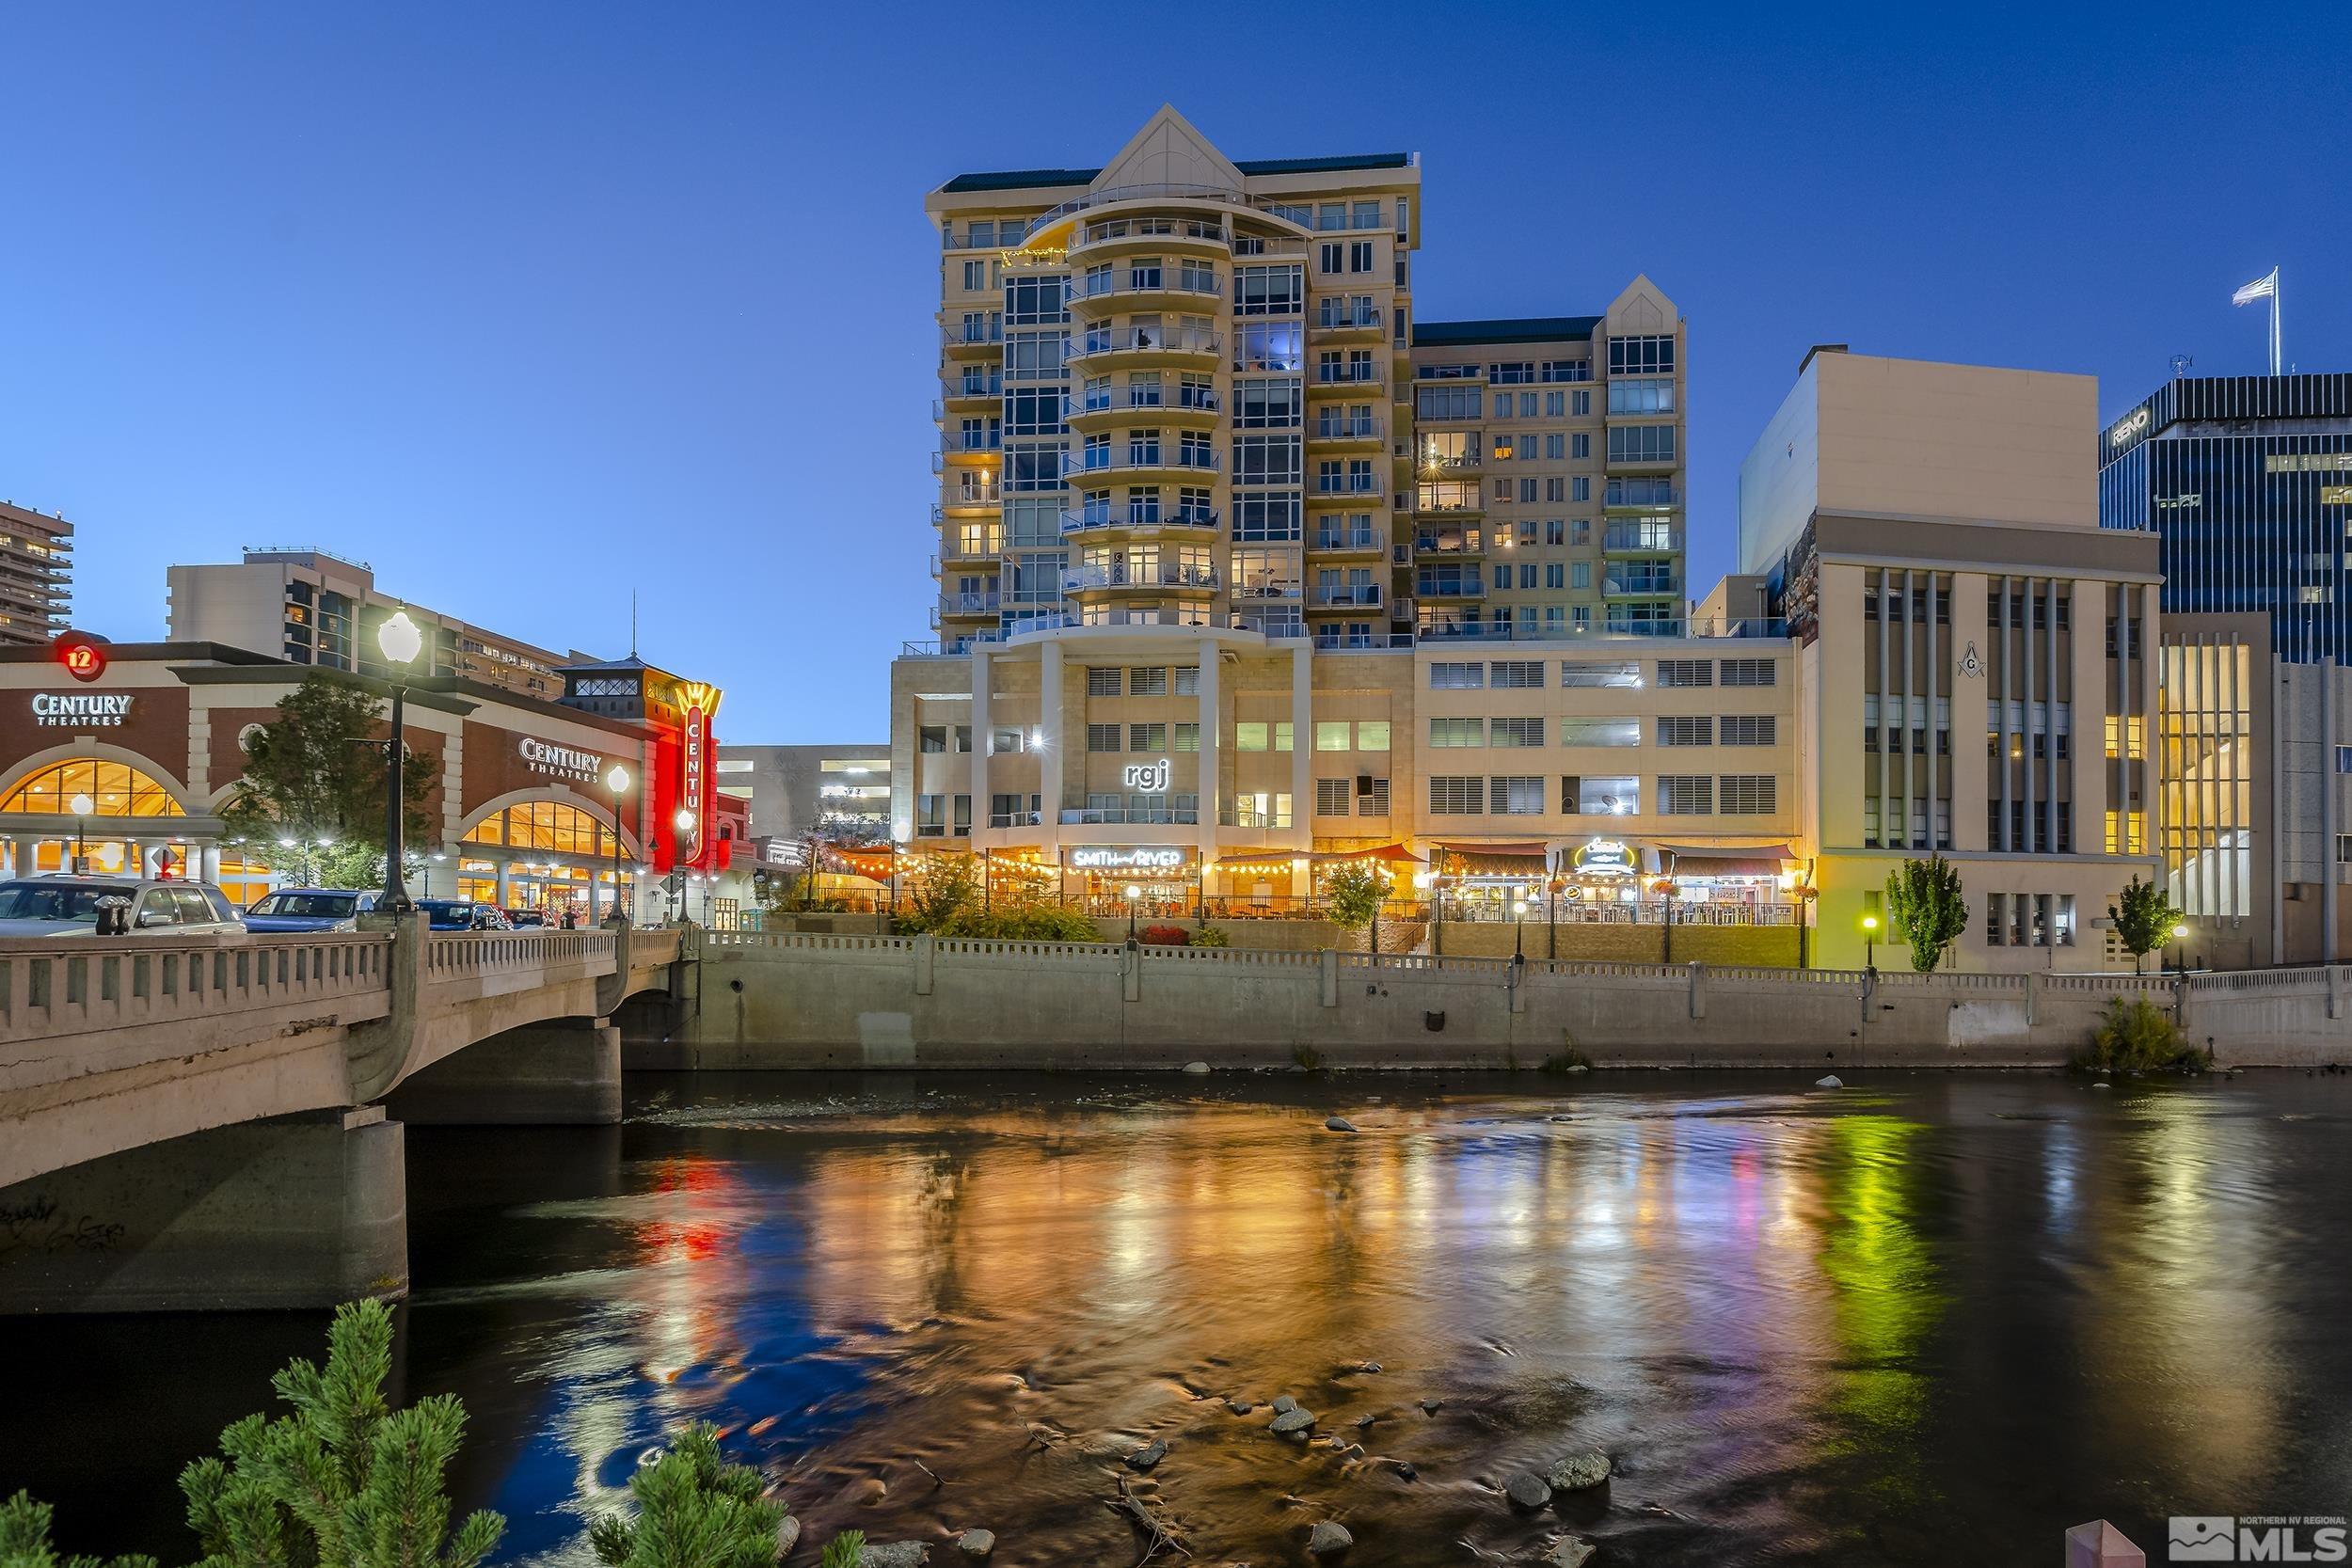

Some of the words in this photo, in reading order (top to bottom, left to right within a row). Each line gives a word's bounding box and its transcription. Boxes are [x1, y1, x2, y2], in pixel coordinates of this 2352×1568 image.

[2113, 411, 2147, 446] RENO
[67, 651, 91, 668] 12
[1967, 658, 1976, 669] G
[32, 693, 135, 715] CENTURY
[38, 716, 121, 726] THEATRES
[519, 737, 602, 773] CENTURY
[529, 762, 598, 784] THEATRES
[1126, 759, 1168, 790] rgj
[1073, 850, 1119, 865] SMITH
[1136, 850, 1181, 865] RIVER
